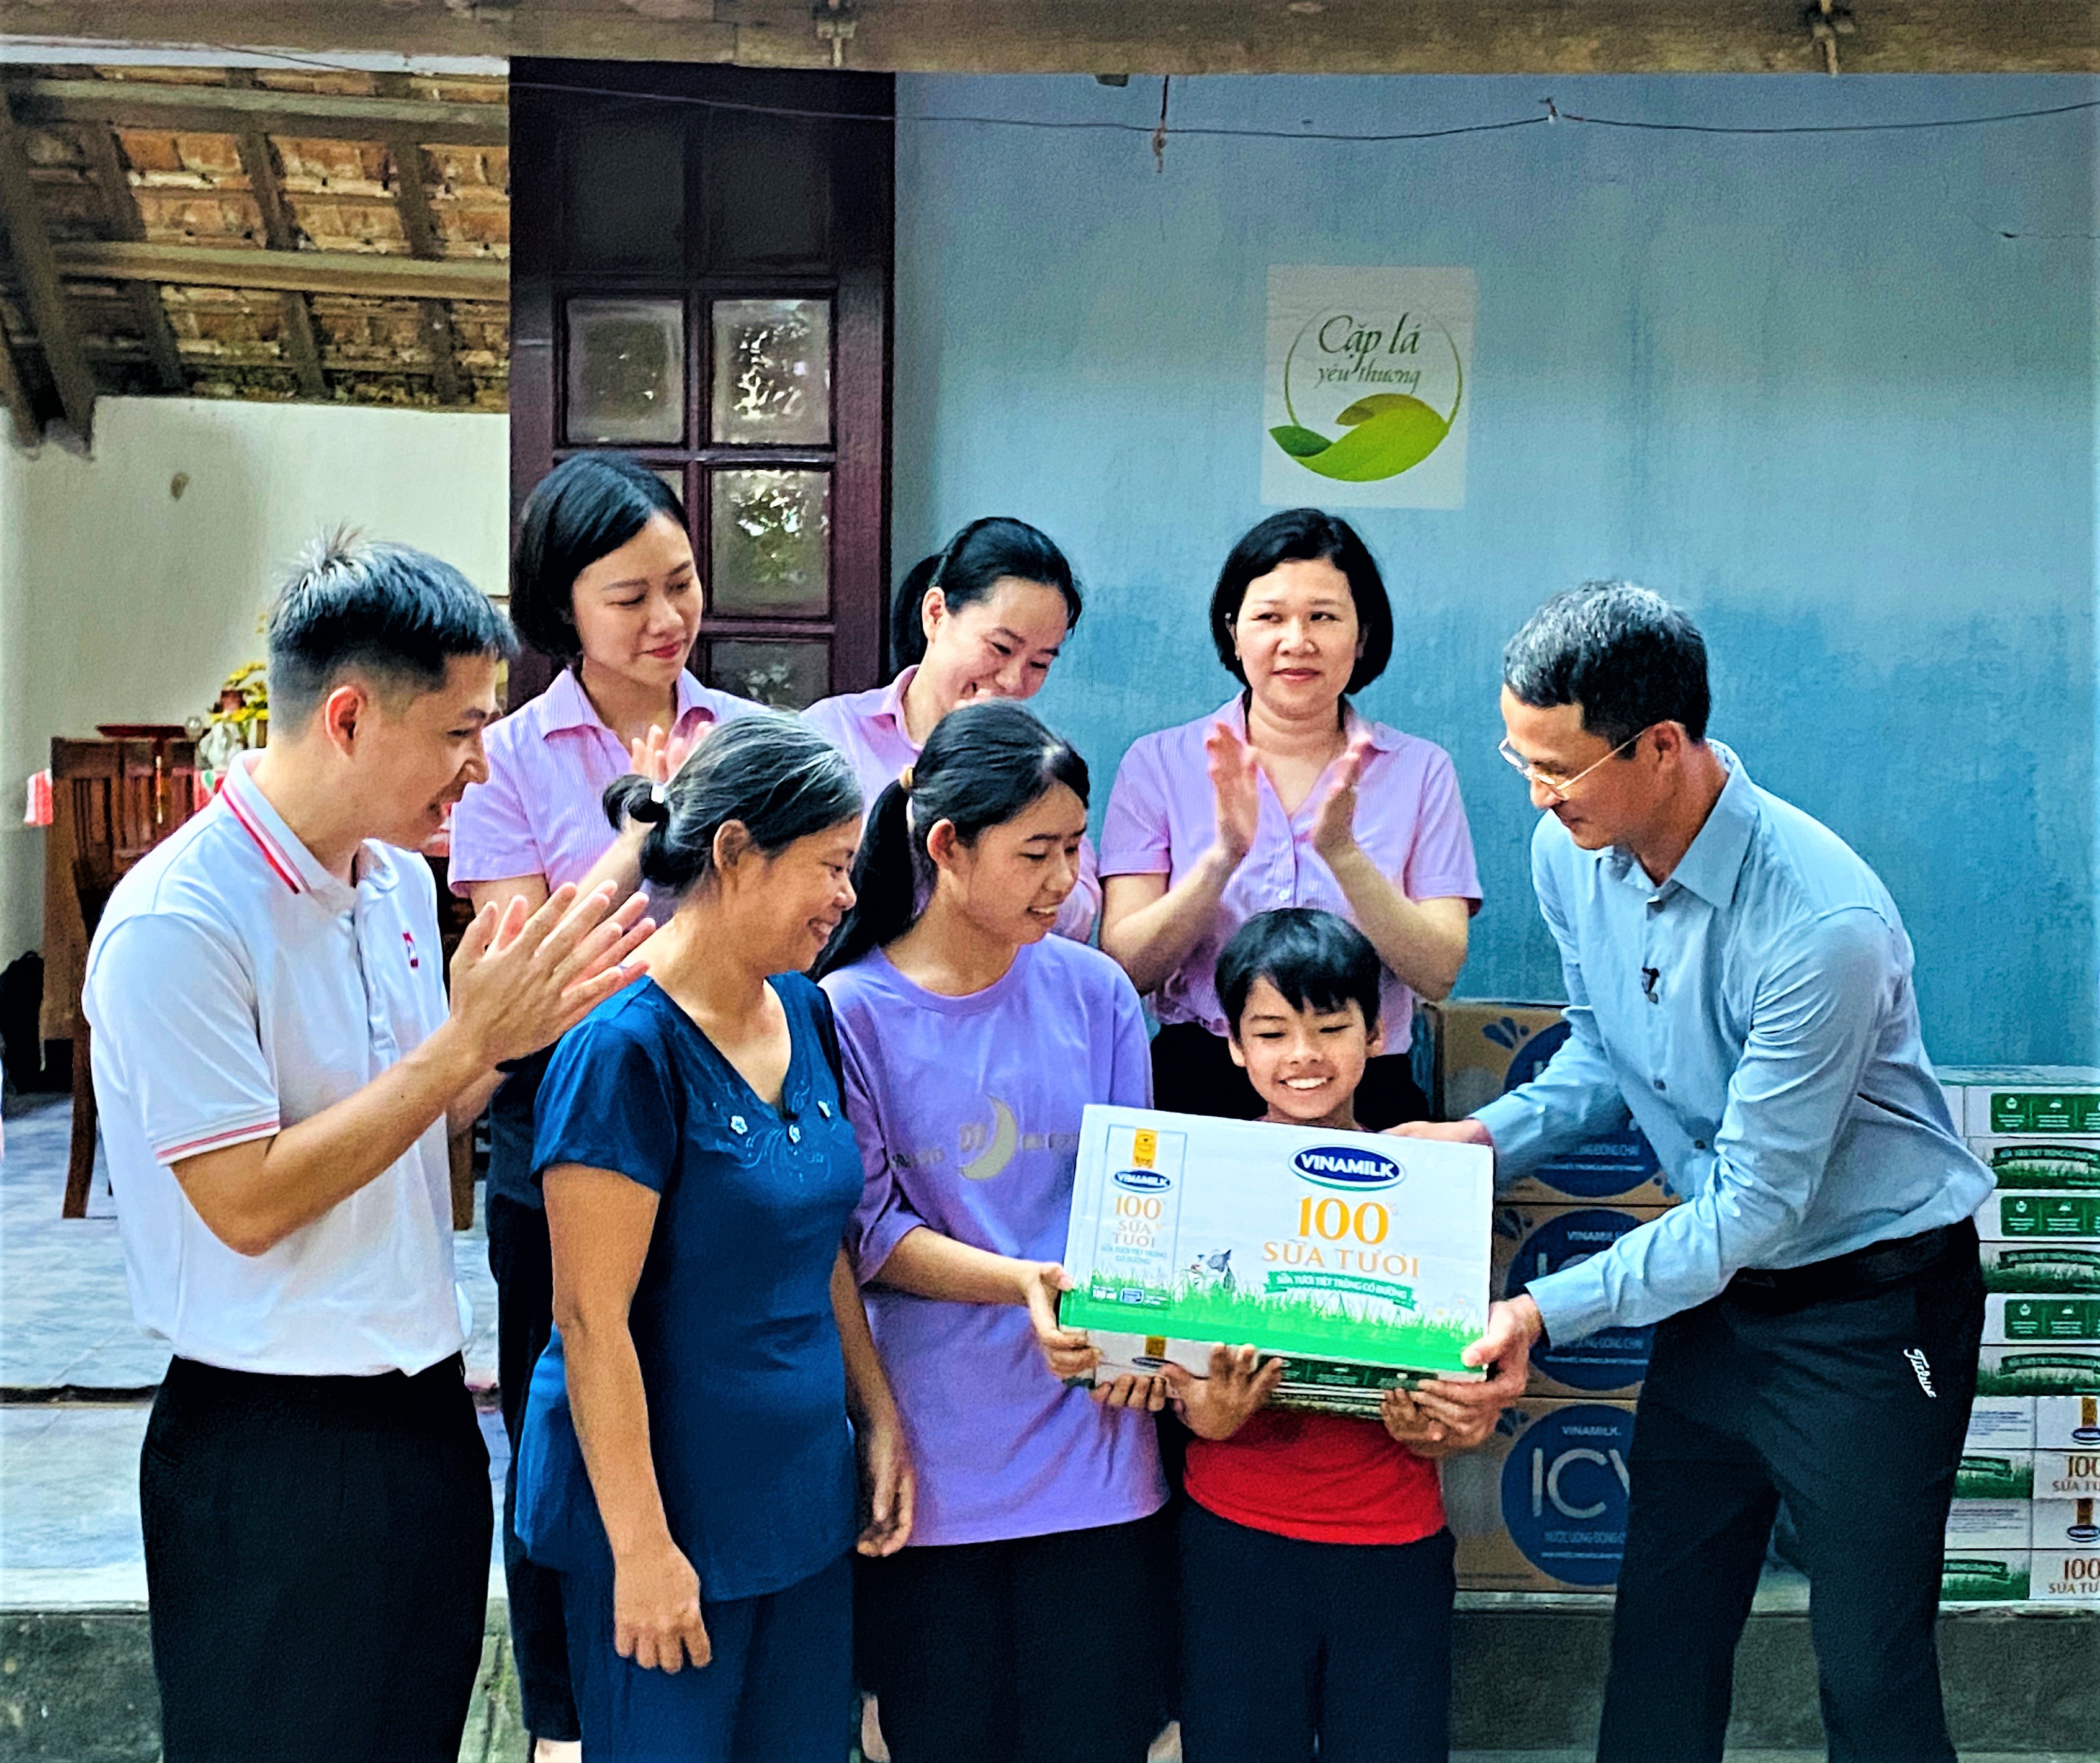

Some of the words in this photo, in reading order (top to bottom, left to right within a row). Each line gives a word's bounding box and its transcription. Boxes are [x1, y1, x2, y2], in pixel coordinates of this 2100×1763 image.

[1319, 314, 1383, 374] Cặp
[1388, 311, 1422, 355] lá
[1116, 1172, 1170, 1188] VINAMILK
[1300, 1153, 1396, 1179] VINAMILK
[1262, 1238, 1326, 1268] SỮA
[1335, 1246, 1419, 1278] TƯƠI
